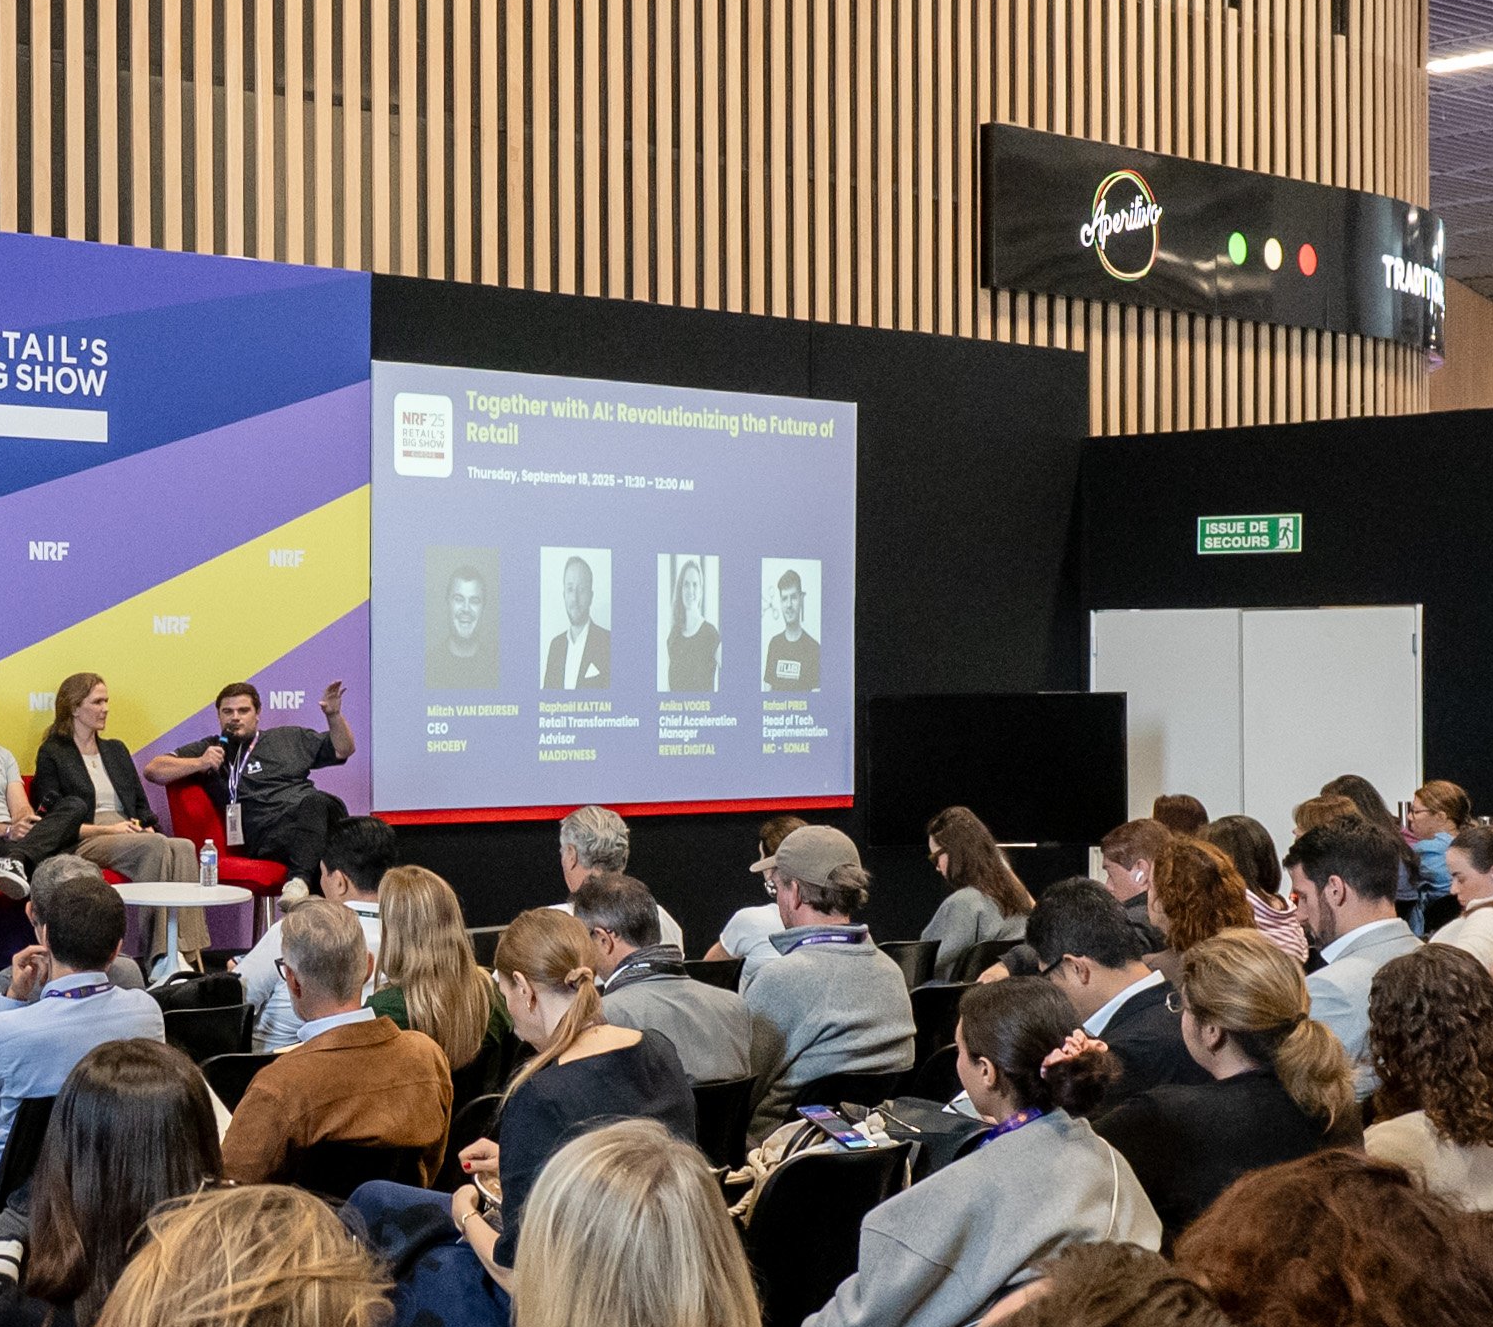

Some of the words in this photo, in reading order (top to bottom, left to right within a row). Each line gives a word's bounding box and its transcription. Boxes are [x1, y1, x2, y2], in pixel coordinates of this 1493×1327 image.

[1080, 195, 1163, 250] Aperitivo
[15, 365, 107, 396] SHOW
[402, 412, 427, 425] NRF
[466, 390, 547, 420] Together
[551, 397, 589, 419] with
[593, 402, 614, 421] AI:
[617, 403, 739, 437] Revolutionizing
[742, 413, 766, 433] the
[770, 415, 817, 437] Future
[820, 419, 834, 438] of
[402, 429, 445, 439] RETAIL'S
[466, 422, 518, 444] Retail
[402, 438, 416, 447] BIG
[419, 439, 445, 449] SHOW
[467, 466, 519, 484] Thursday,
[522, 468, 577, 485] September
[592, 473, 615, 487] 2025
[625, 476, 645, 488] 11:30
[655, 477, 678, 490] 12:00
[679, 479, 694, 491] AM
[1206, 522, 1245, 534] ISSUE
[1250, 521, 1268, 533] DE
[1204, 536, 1269, 548] SECOURS
[29, 540, 69, 561] NRF
[268, 548, 305, 568] NRF
[152, 615, 190, 634] NRF
[29, 691, 55, 711] NR
[269, 690, 305, 711] NRF
[427, 705, 454, 716] Mitch
[456, 706, 476, 716] VAN
[478, 705, 518, 716] DEURSEN
[577, 702, 611, 713] KATTAN
[539, 716, 566, 728] Retail
[568, 715, 639, 728] Transformation
[659, 715, 682, 726] Chief
[683, 714, 737, 726] Acceleration
[763, 715, 784, 726] Head
[785, 715, 793, 726] of
[794, 715, 813, 726] Tech
[427, 722, 448, 734] CEO
[659, 728, 698, 741] Manager
[763, 726, 828, 740] Experimentation
[539, 733, 575, 745] Advisor
[427, 740, 467, 752] SHOEBY
[659, 744, 683, 756] REWE
[684, 743, 715, 755] DIGITAL
[763, 743, 776, 754] MC
[783, 742, 810, 754] SONAE
[539, 749, 597, 762] MADDYNESS
